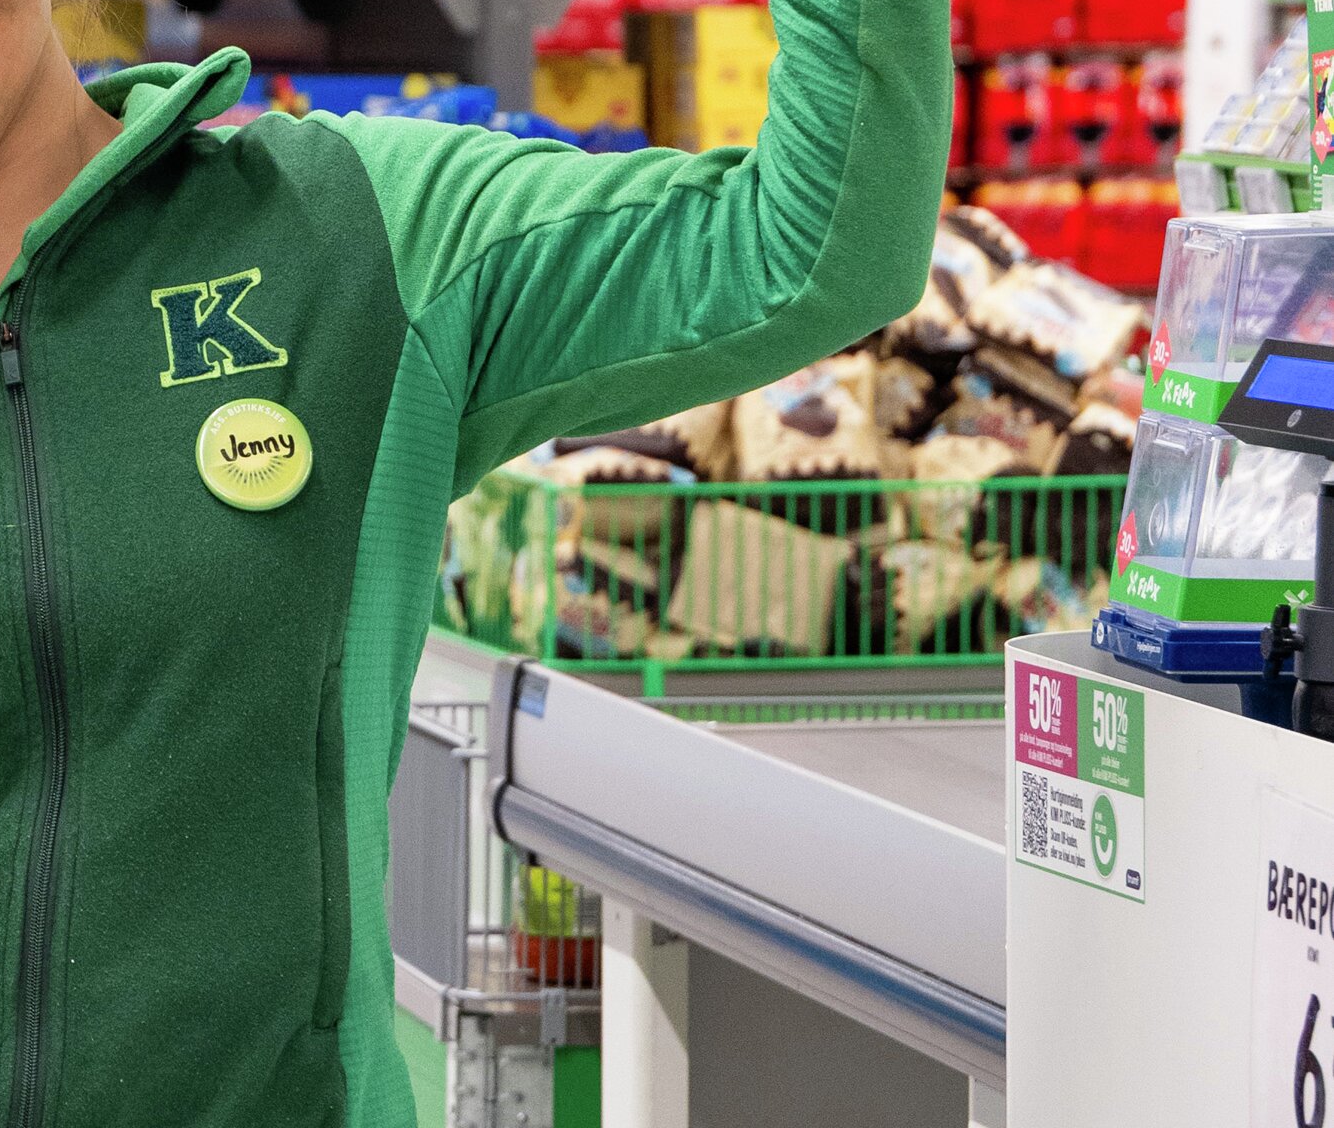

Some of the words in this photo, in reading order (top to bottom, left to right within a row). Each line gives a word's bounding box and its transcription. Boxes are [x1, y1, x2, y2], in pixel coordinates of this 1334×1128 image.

[151, 267, 288, 388] K
[1153, 340, 1169, 365] 30,-
[1173, 381, 1196, 409] FLAX
[211, 416, 229, 435] ASS.
[227, 403, 287, 424] BUTIKKSJEF
[220, 434, 295, 462] Jenny
[1120, 530, 1135, 558] 30,-
[1137, 575, 1161, 602] FLAX
